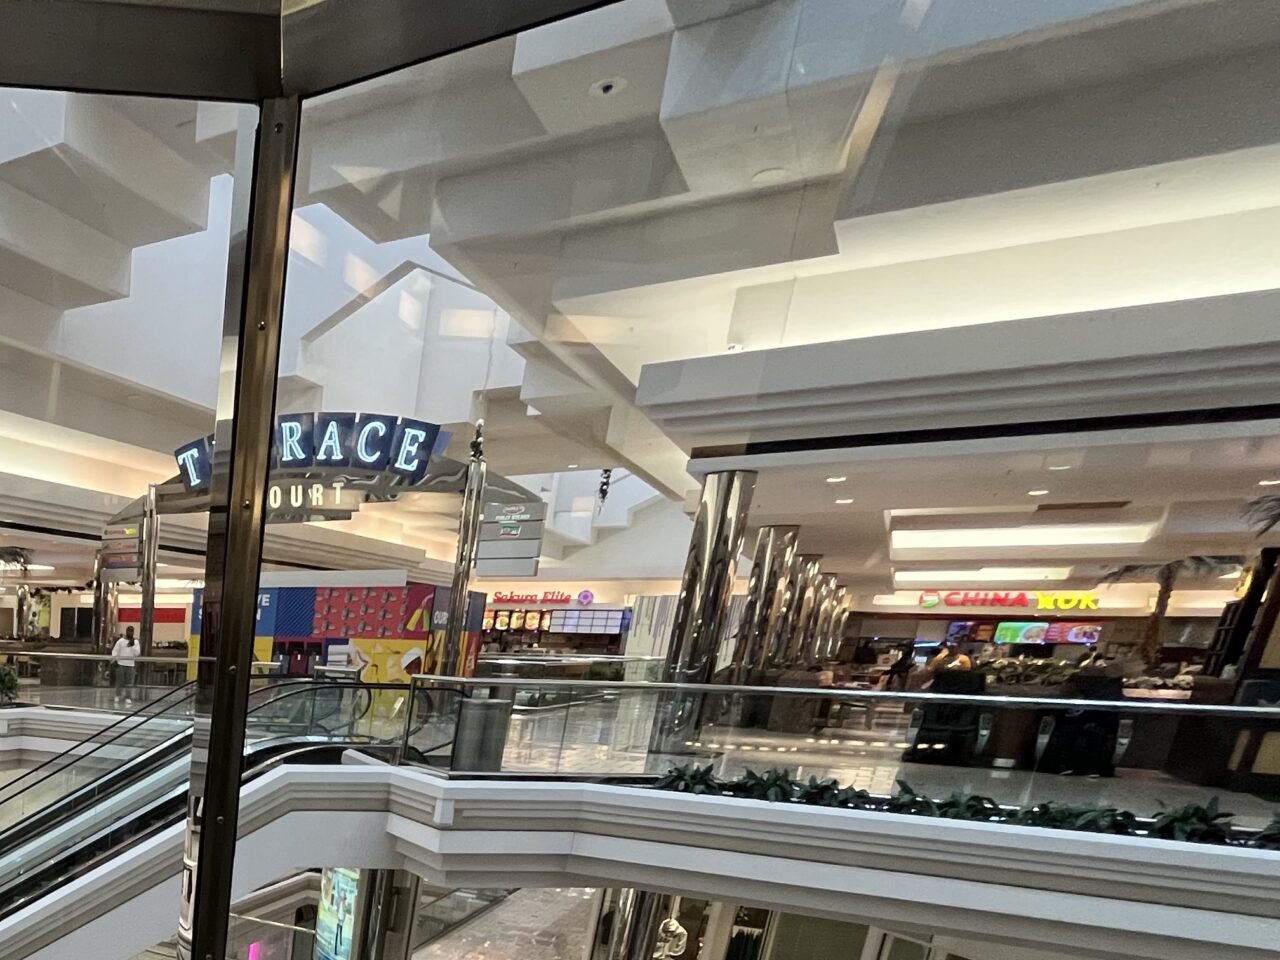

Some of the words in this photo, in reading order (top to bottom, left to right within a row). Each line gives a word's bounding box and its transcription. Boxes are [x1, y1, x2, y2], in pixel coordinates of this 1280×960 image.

[177, 420, 426, 487] TRACE
[269, 482, 346, 509] OURT
[493, 591, 537, 604] Sakura
[541, 591, 572, 604] Elite
[944, 591, 1029, 608] CHINA
[1035, 592, 1099, 610] WOK
